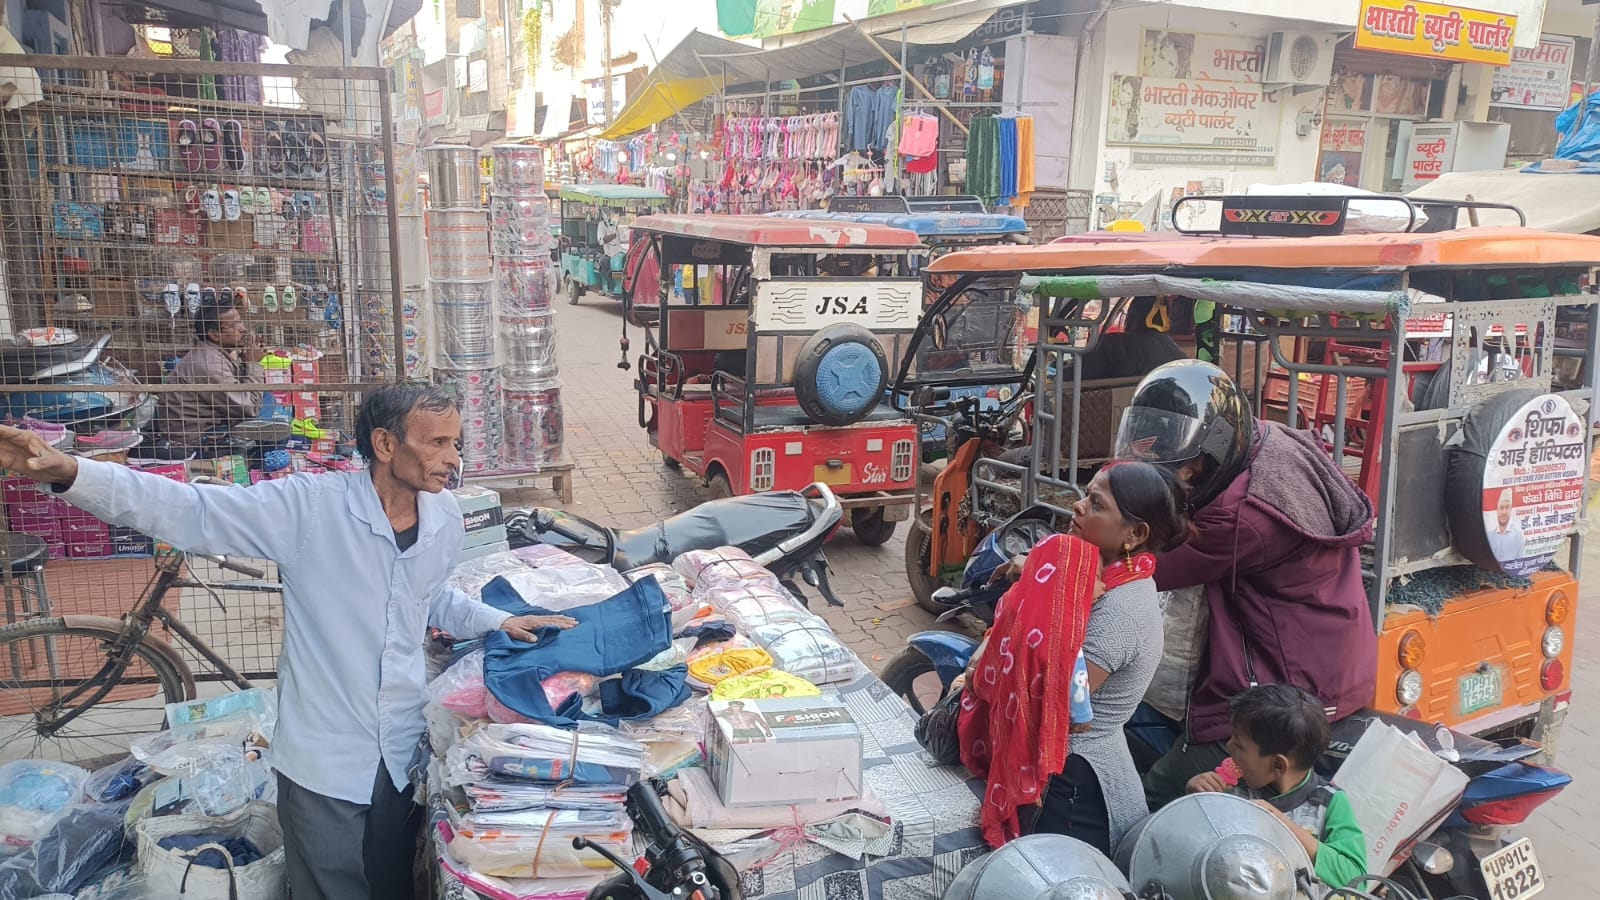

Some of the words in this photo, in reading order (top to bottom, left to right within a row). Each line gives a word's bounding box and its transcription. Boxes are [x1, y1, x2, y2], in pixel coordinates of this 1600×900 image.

[1365, 4, 1419, 36] भारती
[1467, 18, 1513, 50] पार्लर
[1214, 44, 1265, 73] भारती
[1144, 82, 1188, 107] भारती
[1191, 84, 1258, 110] मेकओवर
[1199, 111, 1237, 130] पार्लर
[1412, 155, 1443, 172] पार्लर
[815, 295, 869, 315] JSA
[725, 322, 748, 335] JS
[1524, 410, 1566, 439] शिफा
[1498, 441, 1527, 467] आई
[1529, 438, 1583, 465] हॉस्पिटल
[862, 462, 888, 485] Star
[465, 513, 490, 524] SHION
[775, 711, 842, 723] FASHION
[1489, 846, 1528, 877] UP91L
[1493, 864, 1540, 900] 1822
